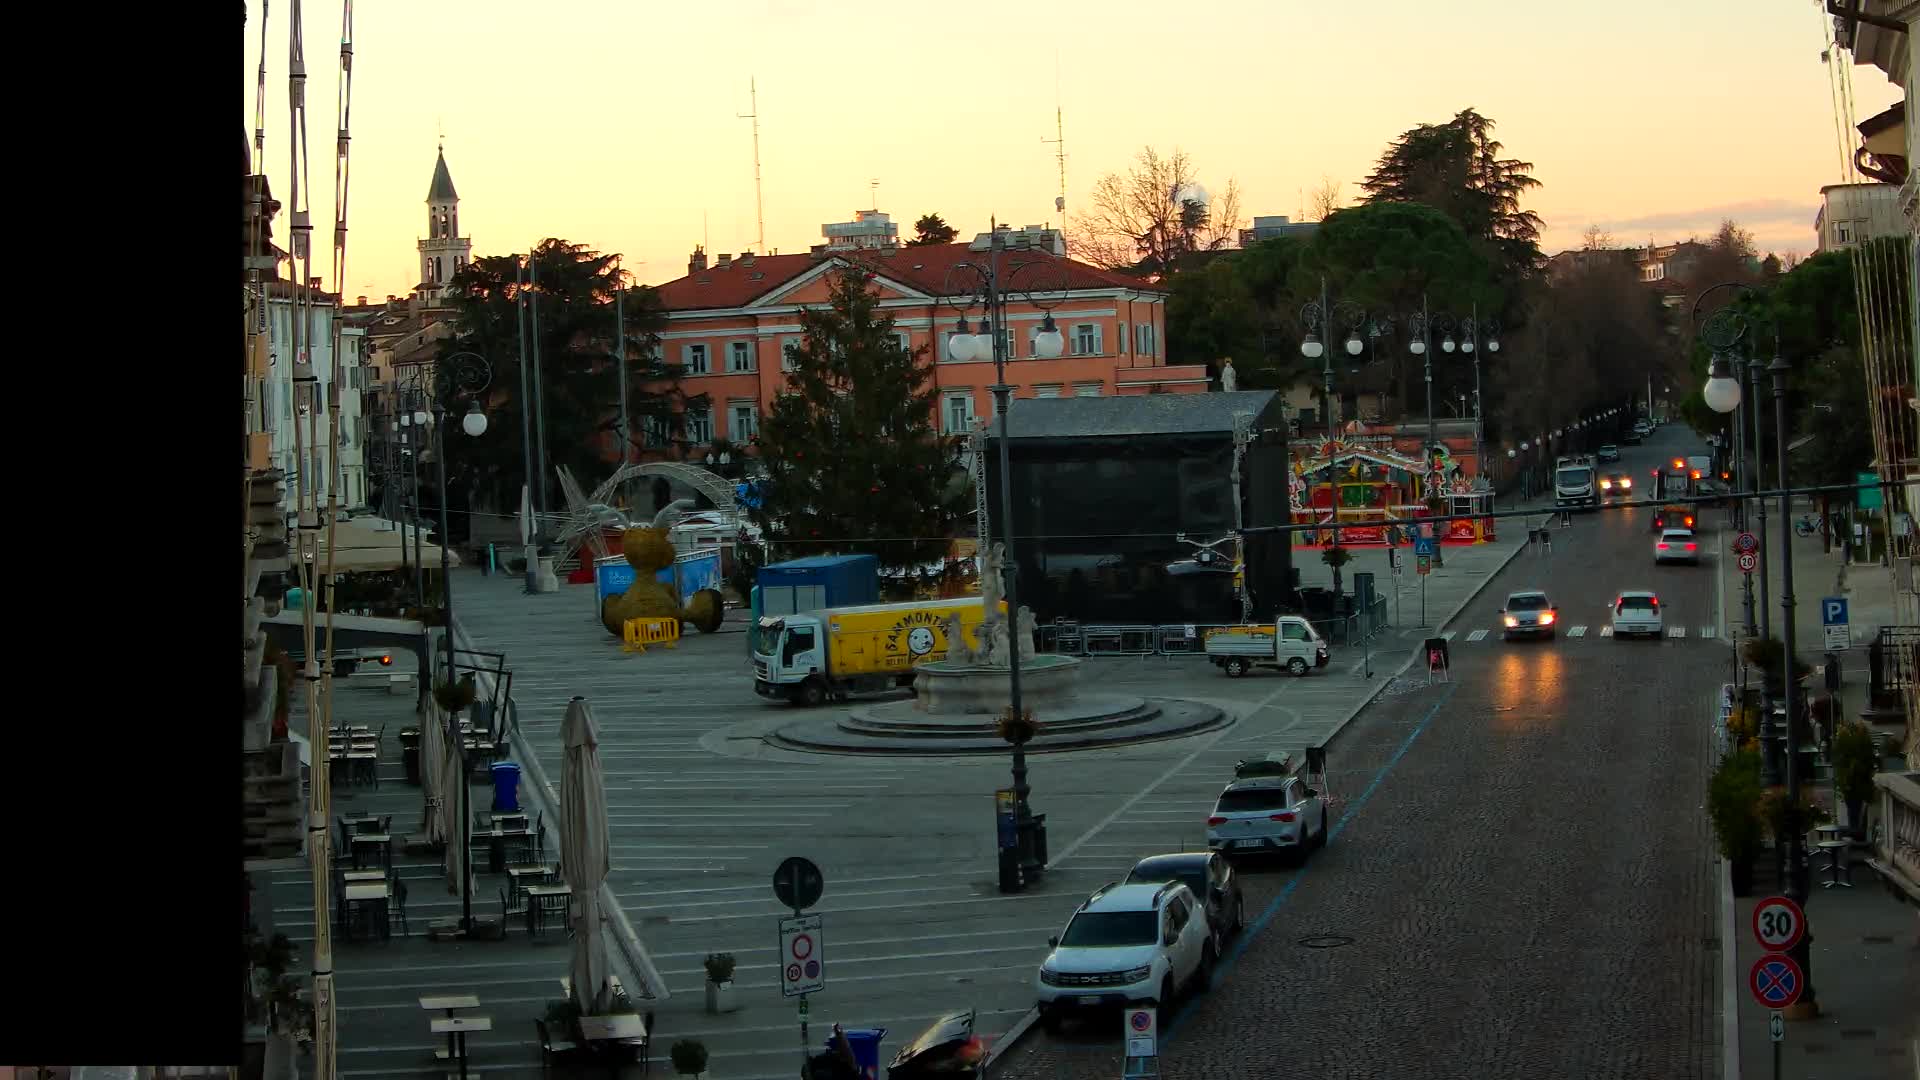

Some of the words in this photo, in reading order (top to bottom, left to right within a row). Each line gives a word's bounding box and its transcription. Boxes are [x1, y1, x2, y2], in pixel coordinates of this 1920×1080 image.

[1742, 557, 1752, 566] 20
[1827, 602, 1842, 622] P
[884, 612, 949, 651] SAMMONTAN
[1762, 911, 1792, 937] 30
